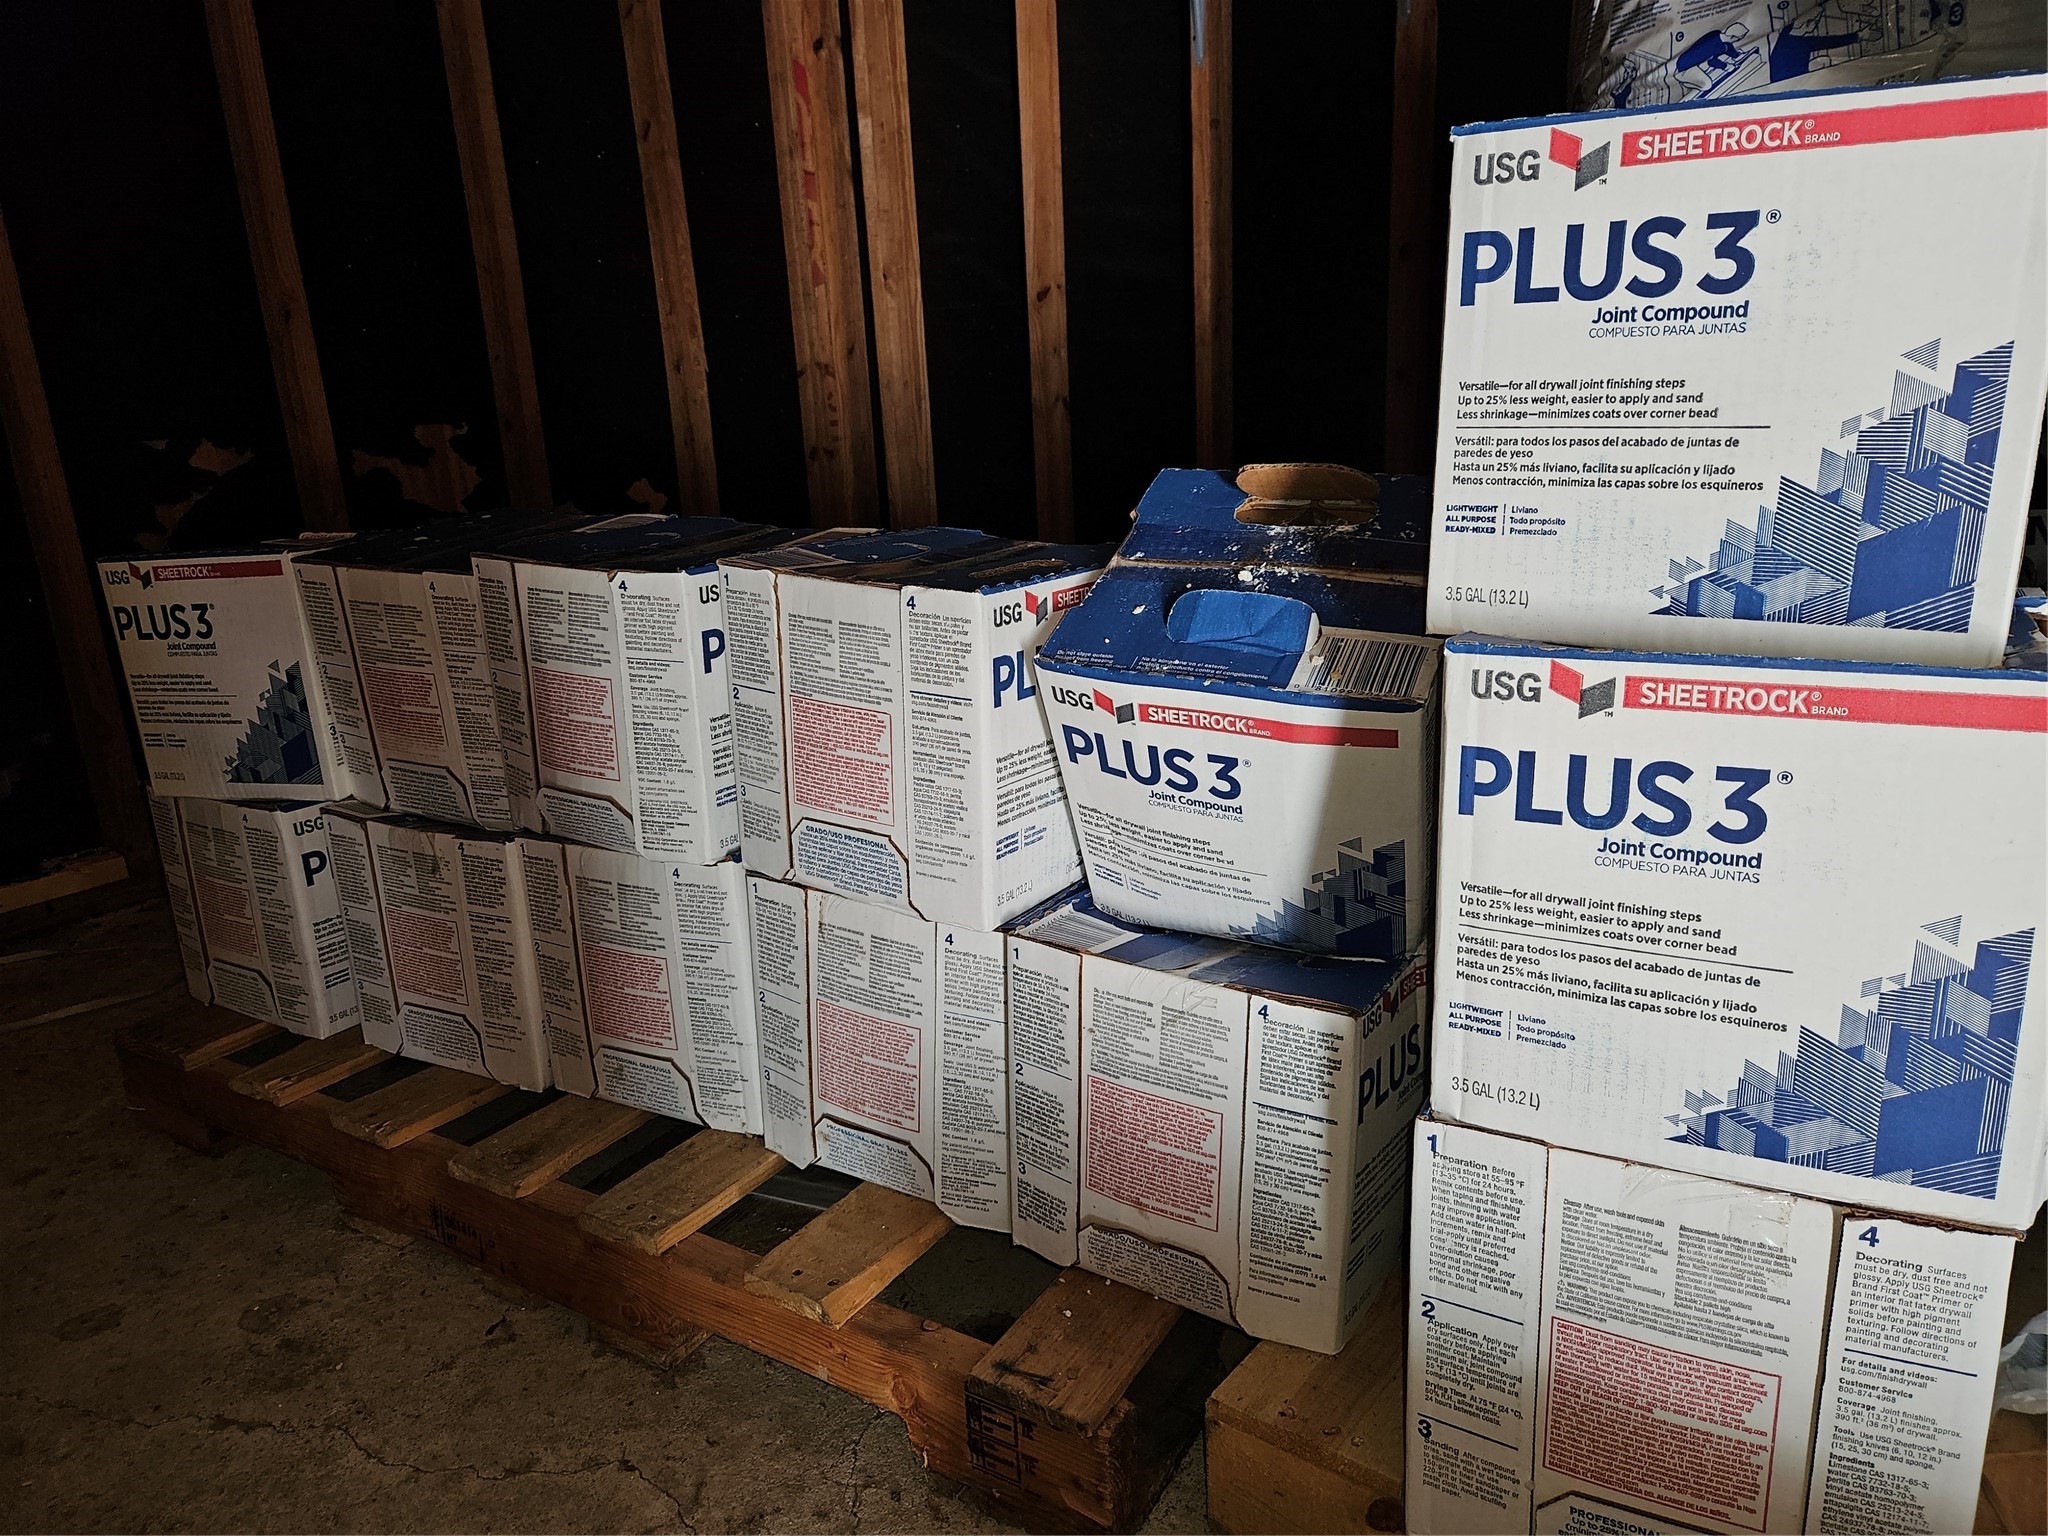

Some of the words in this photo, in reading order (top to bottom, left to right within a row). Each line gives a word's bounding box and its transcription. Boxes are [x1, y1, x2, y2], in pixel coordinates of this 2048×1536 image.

[1474, 150, 1540, 185] USG
[1805, 130, 1841, 144] BRAND
[1460, 216, 1685, 307] PLUS
[1592, 306, 1640, 325] Joint
[1645, 301, 1750, 323] Compound
[1588, 324, 1660, 339] COMPUESTO
[1663, 322, 1695, 337] PARA
[1698, 320, 1747, 336] JUNTAS
[1524, 380, 1537, 389] all
[1539, 379, 1577, 391] drywall
[1579, 378, 1604, 391] joint
[1606, 378, 1652, 390] finishing
[1655, 378, 1685, 389] steps
[1458, 395, 1471, 406] Up
[1474, 396, 1484, 405] to
[1486, 395, 1507, 404] 25%
[1509, 394, 1528, 404] less
[1531, 394, 1568, 405] weight,
[1571, 393, 1603, 404] easier
[1605, 394, 1616, 403] to
[1619, 393, 1650, 405] apply
[1652, 393, 1673, 403] and
[1676, 392, 1703, 403] sand
[1457, 409, 1477, 419] Less
[1592, 409, 1621, 418] coats
[1623, 410, 1648, 418] over
[1650, 410, 1686, 418] corner
[1688, 407, 1718, 418] bead
[1454, 448, 1492, 458] paredes
[1494, 448, 1507, 457] de
[1510, 450, 1533, 459] yeso
[1455, 436, 1494, 445] Versátil:
[1496, 438, 1518, 447] para
[1521, 436, 1549, 446] todos
[1552, 436, 1567, 446] los
[1569, 438, 1599, 447] pasos
[1602, 436, 1619, 446] del
[1621, 436, 1667, 447] acabado
[1670, 437, 1684, 446] de
[1686, 437, 1721, 448] juntas
[1724, 436, 1739, 447] de
[1453, 462, 1480, 471] Hasta
[1496, 462, 1517, 471] 25%
[1520, 462, 1540, 472] más
[1543, 462, 1579, 474] liviano,
[1582, 462, 1618, 473] facilita
[1620, 465, 1632, 473] su
[1634, 463, 1690, 475] aplicación
[1693, 466, 1700, 476] y
[1703, 464, 1735, 476] lijado
[699, 585, 720, 605] US
[1446, 586, 1462, 602] 3.5
[1465, 587, 1486, 603] GAL
[1489, 589, 1517, 607] (13.2
[1519, 590, 1529, 609] L)
[993, 602, 1022, 628] USG
[993, 645, 1043, 709] PL
[1051, 686, 1094, 711] USG
[1471, 669, 1541, 703] USG
[1812, 705, 1849, 717] BRAND
[1062, 724, 1199, 793] PLUS
[1149, 790, 1177, 803] Joint
[1179, 796, 1243, 815] Compound
[1458, 745, 1694, 837] PLUS
[1149, 800, 1192, 814] COMPUESTO
[1193, 808, 1214, 818] PARA
[1215, 812, 1244, 823] JUNTAS
[1597, 838, 1645, 858] Joint
[1650, 841, 1763, 870] Compound
[1594, 856, 1670, 875] COMPUESTO
[1672, 864, 1707, 878] PARA
[1710, 868, 1760, 884] JUNTAS
[1363, 1005, 1382, 1039] USG
[1358, 1023, 1420, 1126] PLUS
[1452, 1077, 1469, 1093] 3.5
[1472, 1081, 1494, 1099] GAL
[1497, 1087, 1526, 1105] (13.2
[1530, 1092, 1540, 1111] L)
[1427, 1134, 1437, 1153] 1
[1430, 1149, 1487, 1171] Preparation
[1492, 1166, 1515, 1178] Before
[1859, 1226, 1880, 1248] 4
[1855, 1251, 1922, 1273] Decorating
[1927, 1265, 1966, 1279] Surfaces
[1853, 1271, 1882, 1283] glossy.
[1884, 1277, 1910, 1289] Apply
[1912, 1282, 1930, 1292] USG
[1854, 1263, 1876, 1272] must
[1879, 1266, 1889, 1274] be
[1892, 1269, 1908, 1279] dry,
[1911, 1273, 1930, 1282] dust
[1933, 1276, 1950, 1286] free
[1953, 1281, 1970, 1289] and
[1973, 1285, 1987, 1293] not
[1421, 1301, 1436, 1320] 2
[1425, 1315, 1478, 1339] Application
[1482, 1334, 1501, 1347] Apply
[1842, 1356, 1856, 1365] For
[1858, 1360, 1886, 1372] details
[1907, 1371, 1937, 1382] videos:
[1839, 1377, 1879, 1391] Customer
[1881, 1386, 1913, 1398] Service
[1418, 1419, 1432, 1439] 3
[1422, 1434, 1459, 1458] Sanding
